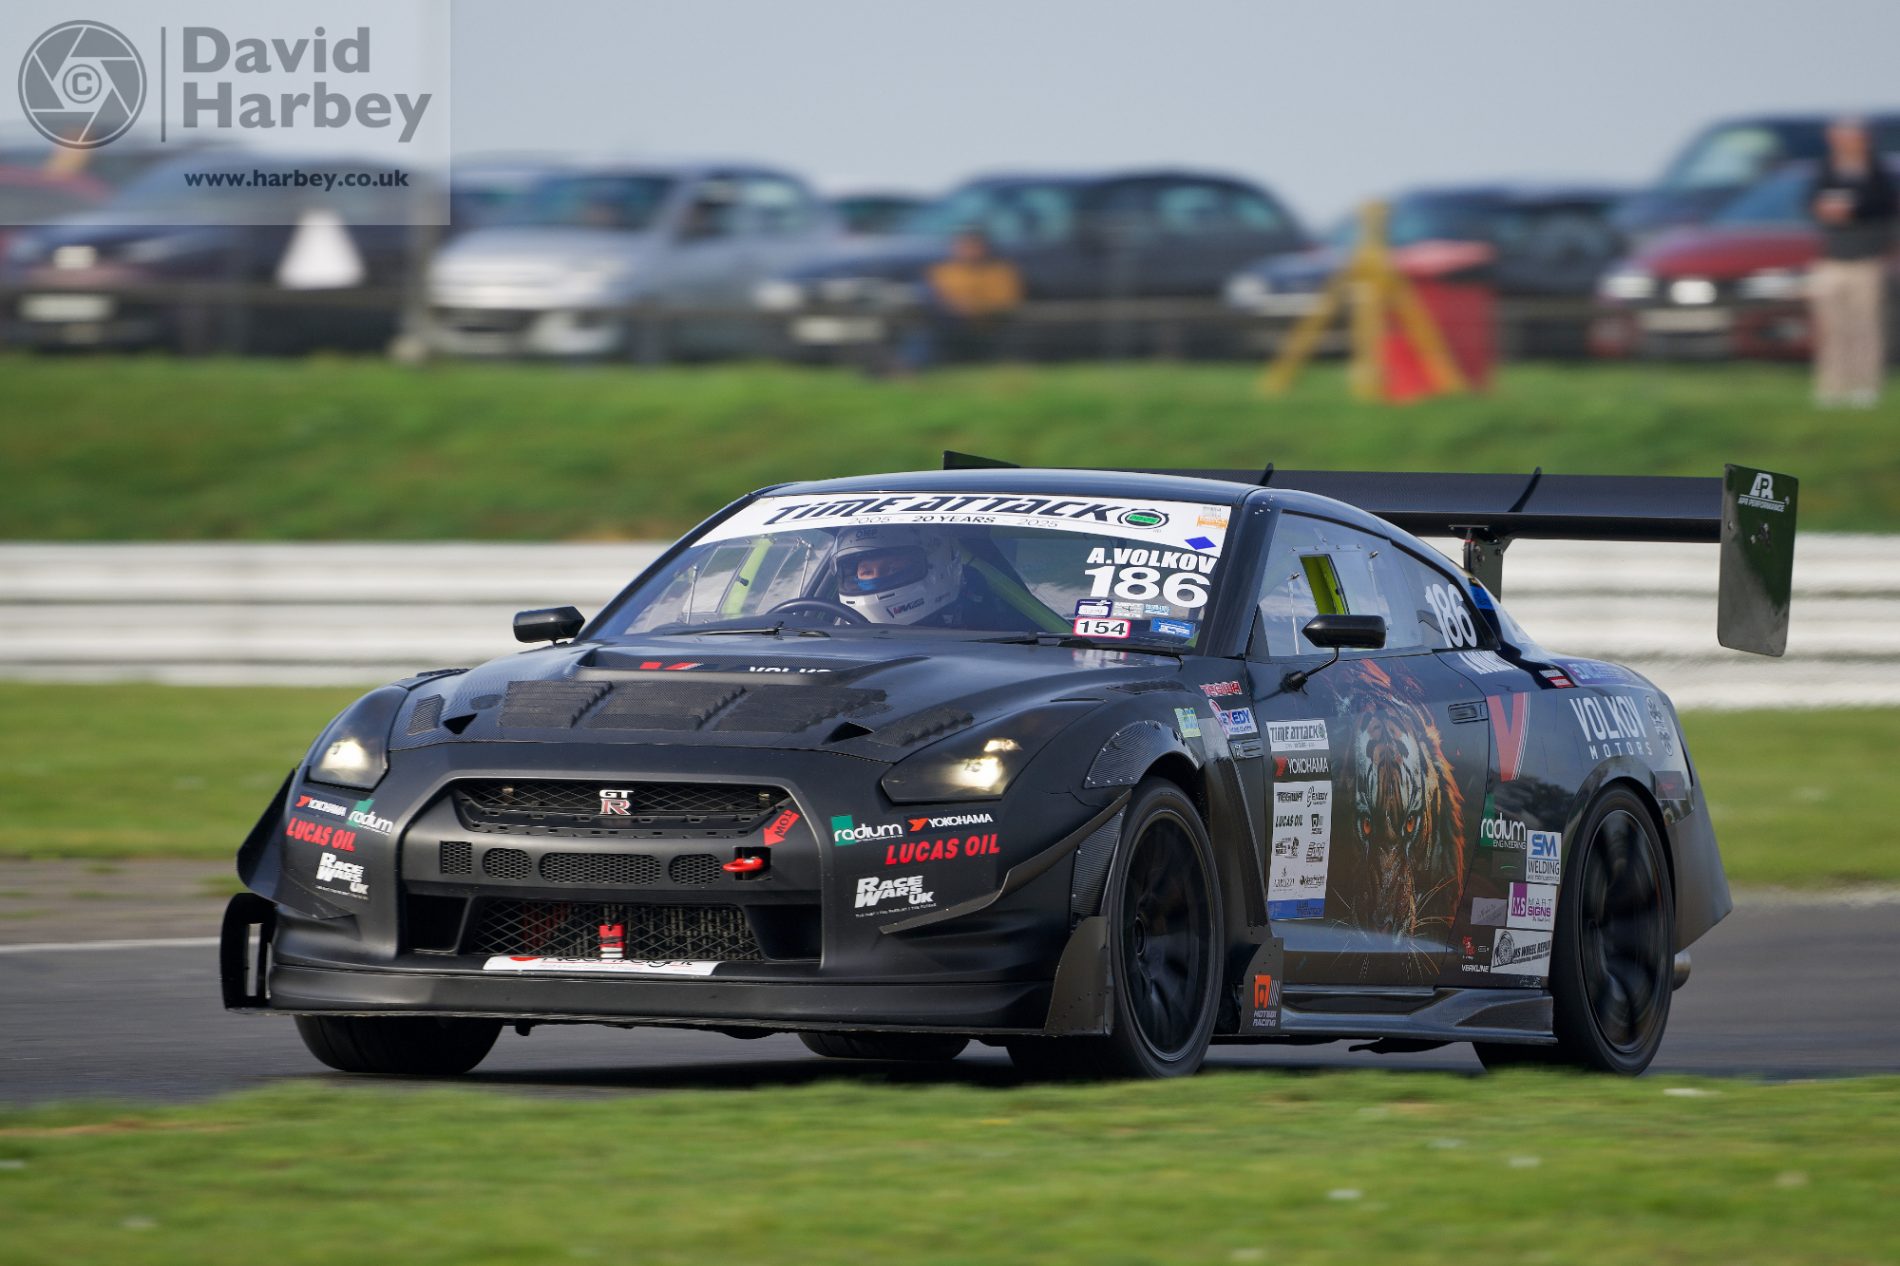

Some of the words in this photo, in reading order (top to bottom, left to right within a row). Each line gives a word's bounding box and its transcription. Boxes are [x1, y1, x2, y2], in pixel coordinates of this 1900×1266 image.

[900, 496, 1122, 522] ATTACK
[912, 515, 929, 523] 20
[938, 515, 996, 524] YEARS
[1016, 518, 1058, 528] 2025
[1086, 547, 1217, 574] A.VOLKOV
[1084, 565, 1210, 608] 186
[1425, 583, 1478, 648] 186
[1080, 621, 1126, 635] 154
[1569, 696, 1647, 742] VOLKOV
[1589, 742, 1653, 760] MOTORS
[1287, 757, 1329, 774] YOKOHAMA
[599, 789, 634, 798] GT
[600, 798, 631, 815] R
[773, 810, 794, 838] TOW
[928, 813, 994, 828] YOKOHAMA
[286, 817, 333, 846] LUCAS
[331, 829, 356, 852] OIL
[885, 838, 959, 865] LUCAS
[964, 833, 1001, 857] OIL
[1493, 840, 1527, 850] ENGINEERING
[1531, 833, 1557, 857] SM
[320, 852, 364, 873] RACE
[1527, 860, 1559, 876] WELDING
[350, 882, 370, 895] UK
[857, 875, 923, 893] RACE
[854, 884, 923, 908] WARS
[908, 891, 935, 905] UK
[1527, 905, 1552, 917] SIGNS
[1252, 1018, 1277, 1027] RACING
